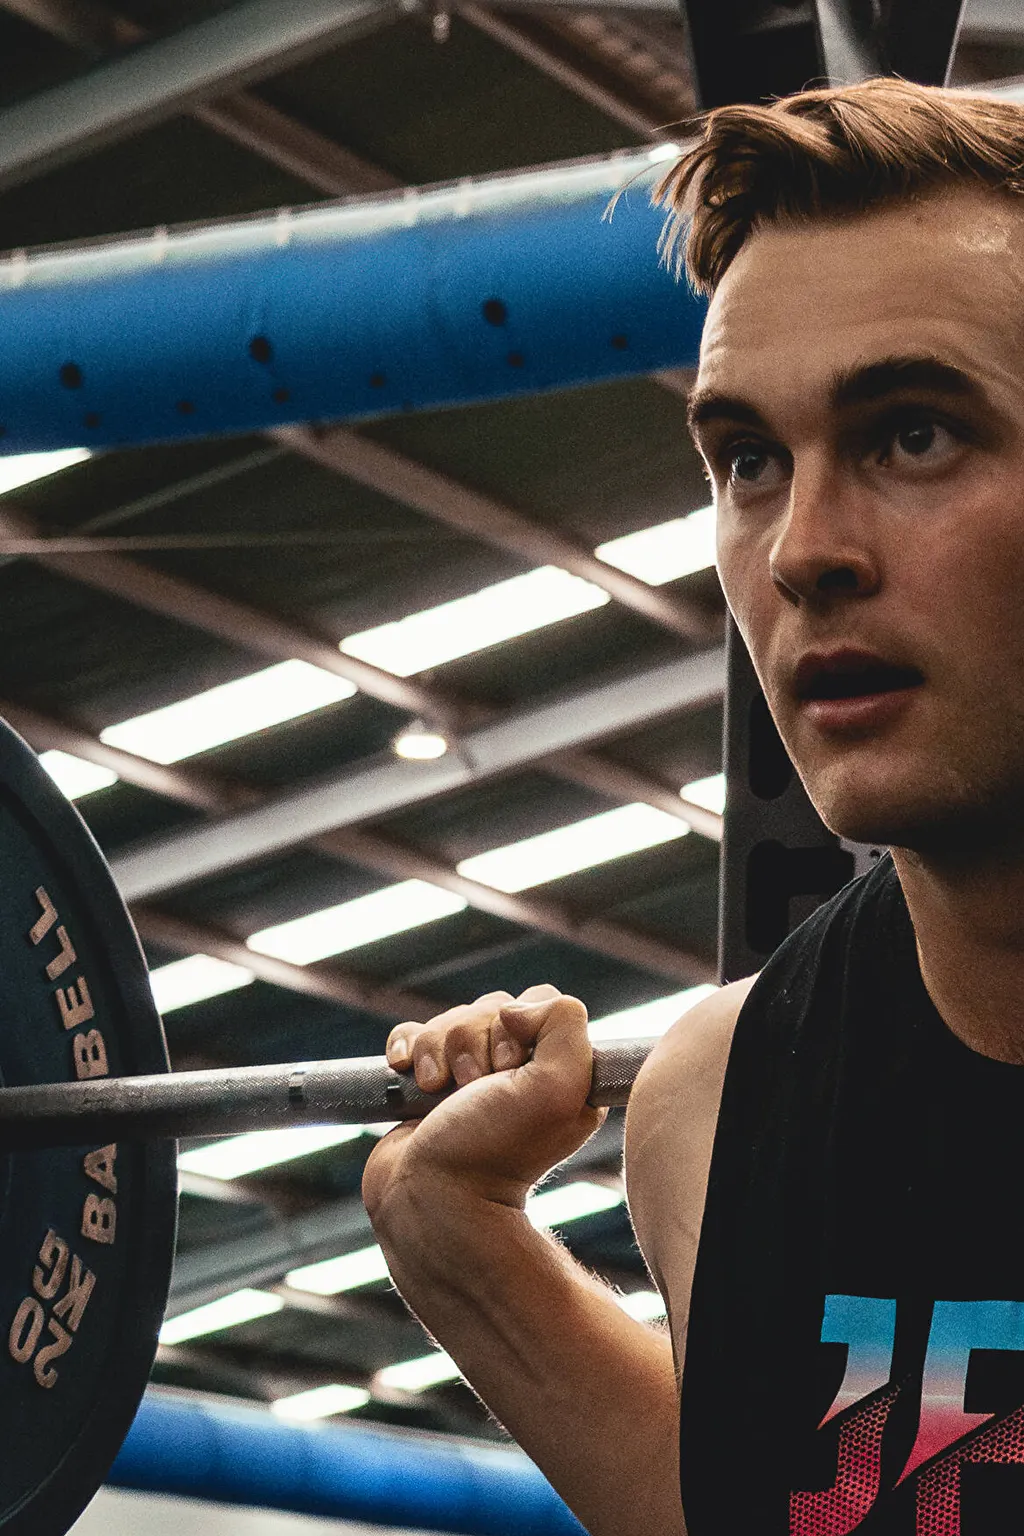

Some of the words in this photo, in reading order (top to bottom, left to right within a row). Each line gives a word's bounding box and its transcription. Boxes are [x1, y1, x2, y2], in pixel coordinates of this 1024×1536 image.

[29, 885, 118, 1245] BABELL
[32, 1228, 97, 1333] KG
[9, 1296, 73, 1388] 20
